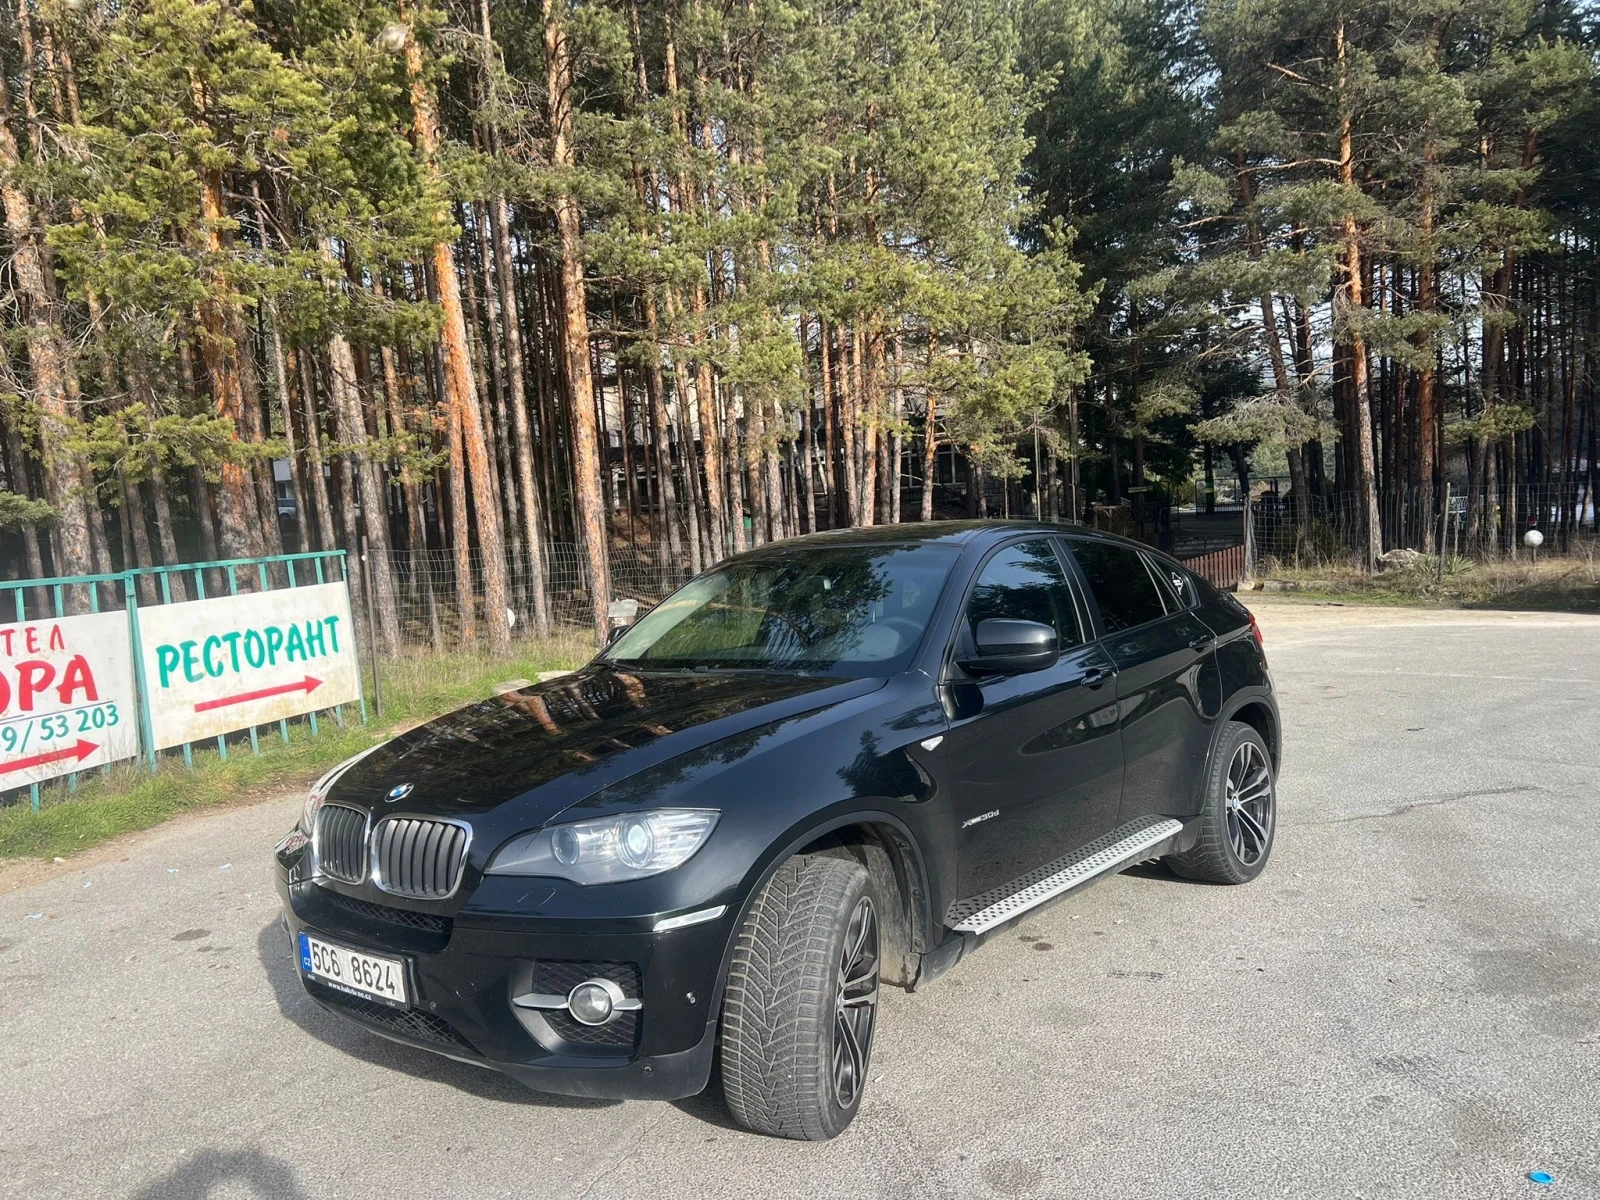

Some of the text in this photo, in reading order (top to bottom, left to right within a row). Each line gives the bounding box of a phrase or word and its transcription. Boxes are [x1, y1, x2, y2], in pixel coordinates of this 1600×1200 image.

[156, 615, 340, 688] РЕСТОРАНТ
[0, 654, 99, 715] РА
[75, 704, 119, 732] 203
[311, 942, 395, 995] 5C6 8624
